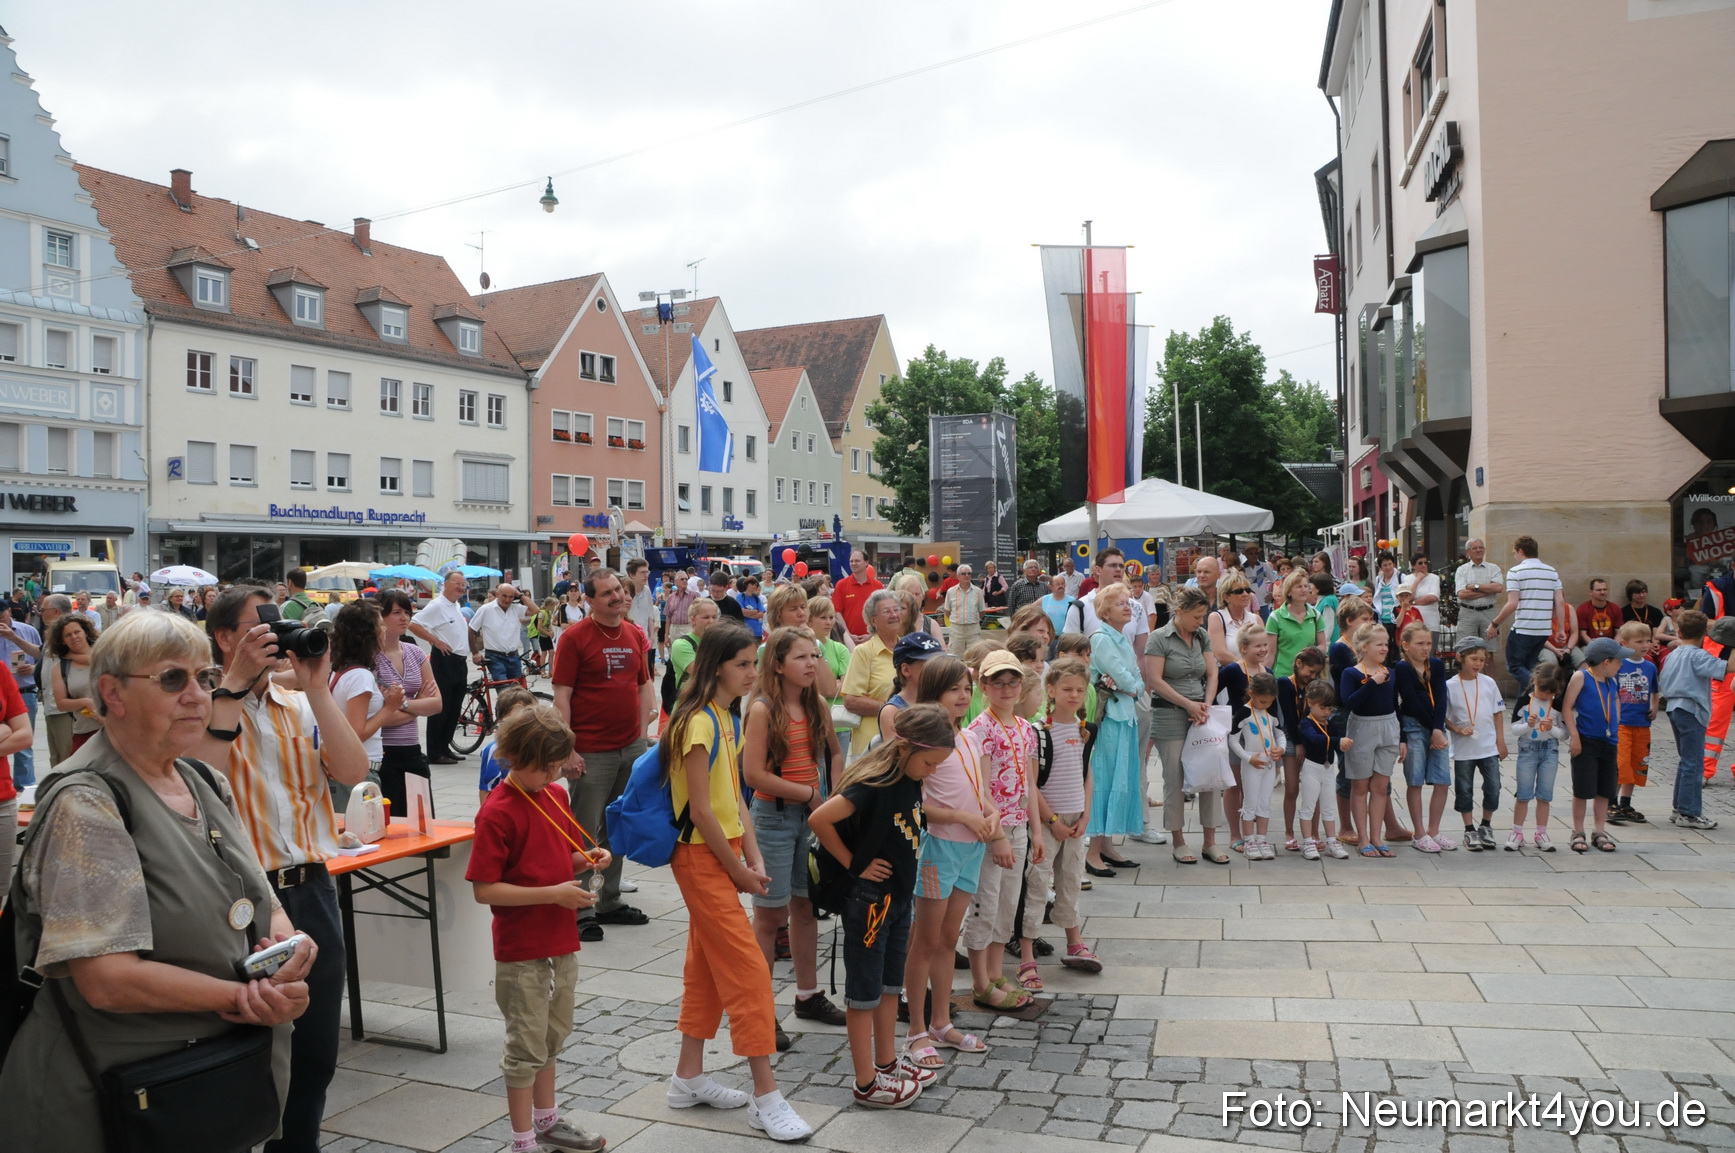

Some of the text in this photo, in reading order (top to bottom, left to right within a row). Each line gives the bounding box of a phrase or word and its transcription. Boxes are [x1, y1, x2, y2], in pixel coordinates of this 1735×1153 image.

[1318, 267, 1333, 309] Achatz
[10, 384, 68, 405] WEBER
[168, 459, 181, 477] R
[8, 492, 78, 512] WEBER
[269, 503, 426, 525] Buchhandlung Rupprecht
